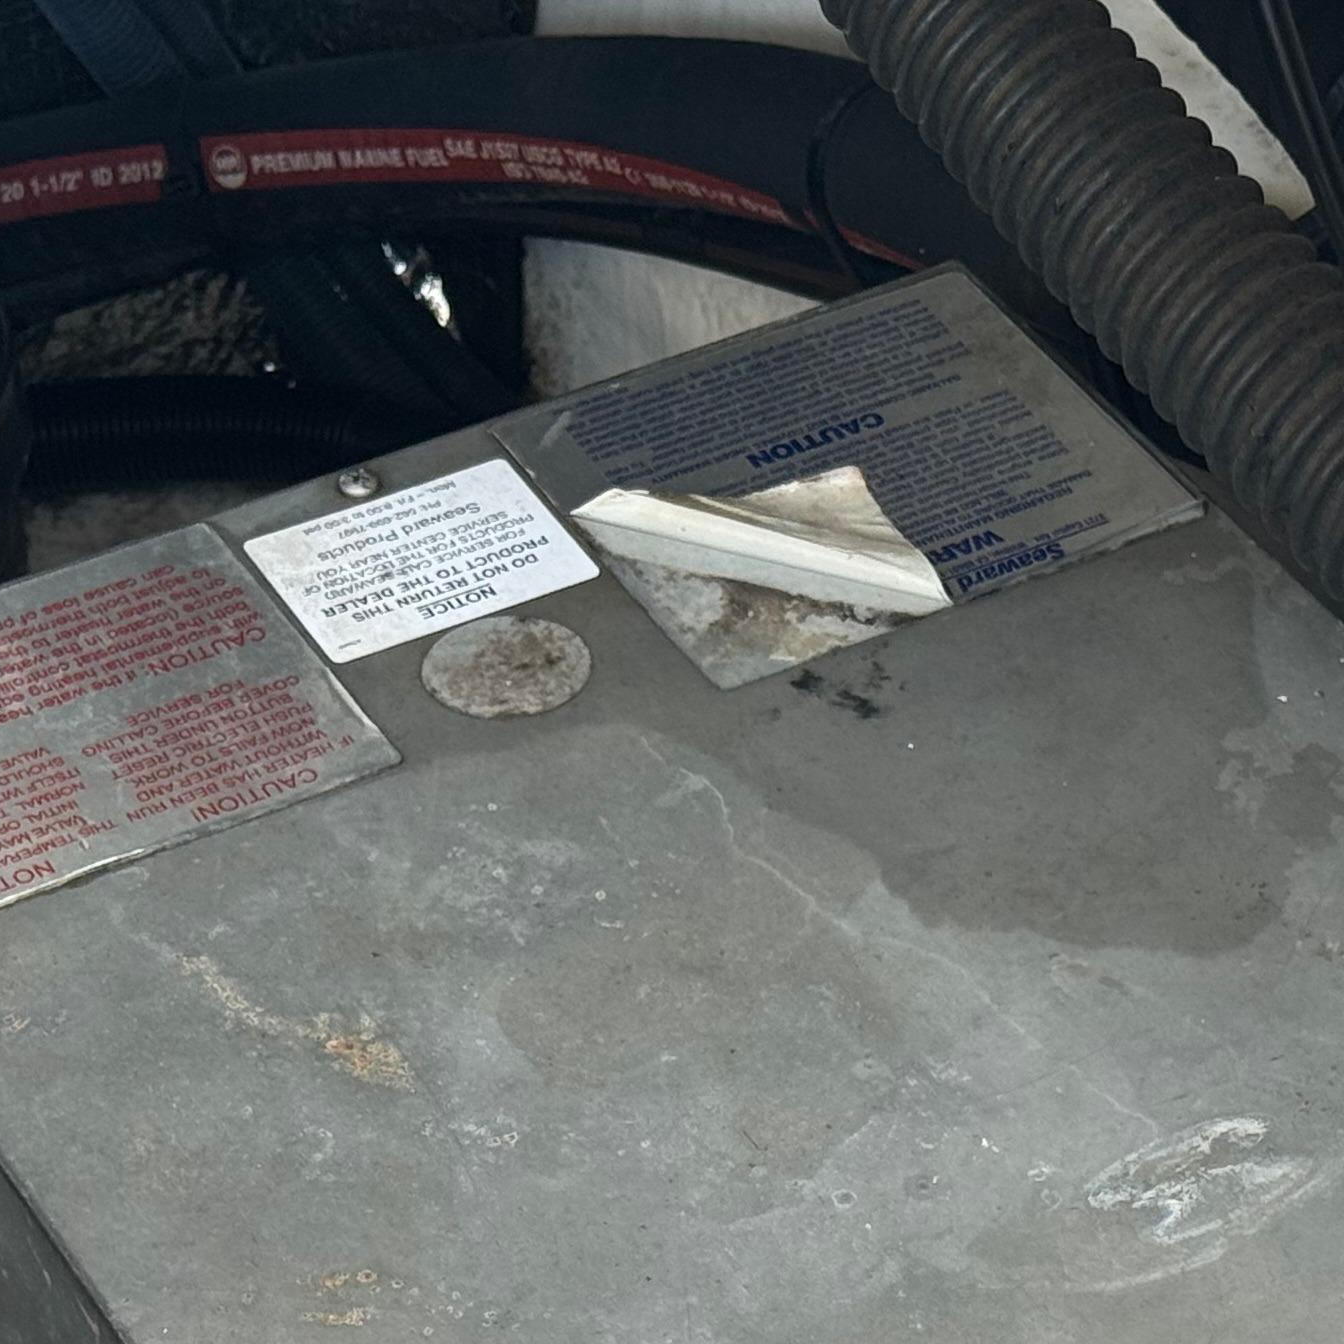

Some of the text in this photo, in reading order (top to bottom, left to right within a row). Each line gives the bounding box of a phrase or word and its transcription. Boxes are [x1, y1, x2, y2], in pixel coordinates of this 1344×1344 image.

[118, 159, 165, 186] 2012
[743, 409, 889, 470] CAUTION
[314, 500, 483, 564] Seaward Products
[455, 512, 536, 544] PRODUCTS
[494, 526, 527, 543] FOR
[313, 510, 510, 581] SERVICE CENTER NEAR YOU
[393, 549, 425, 566] THE
[423, 538, 458, 556] FOR
[432, 537, 496, 564] SERVICE
[138, 563, 180, 585] can
[188, 567, 213, 583] to
[318, 534, 551, 618] PRODUCT TO THE DEALER
[320, 559, 396, 590] LOCATION
[948, 541, 1073, 593] Seaward
[80, 576, 142, 604] cause
[129, 574, 192, 602] adjust
[167, 585, 203, 605] the
[200, 576, 231, 594] on
[349, 552, 539, 623] DO NOT RETURN THIS
[38, 595, 84, 618] loss
[85, 593, 133, 617] both
[112, 596, 170, 624] water
[179, 585, 248, 616] source
[204, 599, 252, 623] both
[415, 585, 498, 620] NOTICE
[16, 609, 42, 626] of
[51, 615, 115, 644] heater
[104, 607, 182, 641] (located
[171, 614, 207, 634] the
[223, 609, 266, 632] with
[28, 635, 53, 652] to
[46, 640, 85, 661] the
[70, 625, 174, 668] thermostat
[81, 633, 106, 649] in
[97, 623, 225, 674] supplemental
[136, 624, 270, 679] CAUTION:
[24, 665, 100, 699] heating
[88, 673, 124, 693] the
[32, 685, 89, 712] water
[122, 678, 246, 727] FOR SERVICE
[77, 673, 303, 758] COVER BEFORE CALLING
[105, 691, 295, 764] BUTTON UNDER THIS
[266, 715, 319, 740] NOW
[105, 700, 315, 780] PUSH ELECTRIC RESET
[215, 731, 272, 758] FAILS
[132, 728, 329, 803] WITHOUT WATER AND
[187, 749, 220, 768] TO
[22, 765, 82, 793] ITSELF
[122, 733, 358, 823] IF HEATER HAS BEEN RUN
[187, 766, 321, 823] CAUTION!
[21, 797, 80, 825] INITIAL
[28, 811, 86, 839] VALVE
[76, 817, 117, 838] THIS
